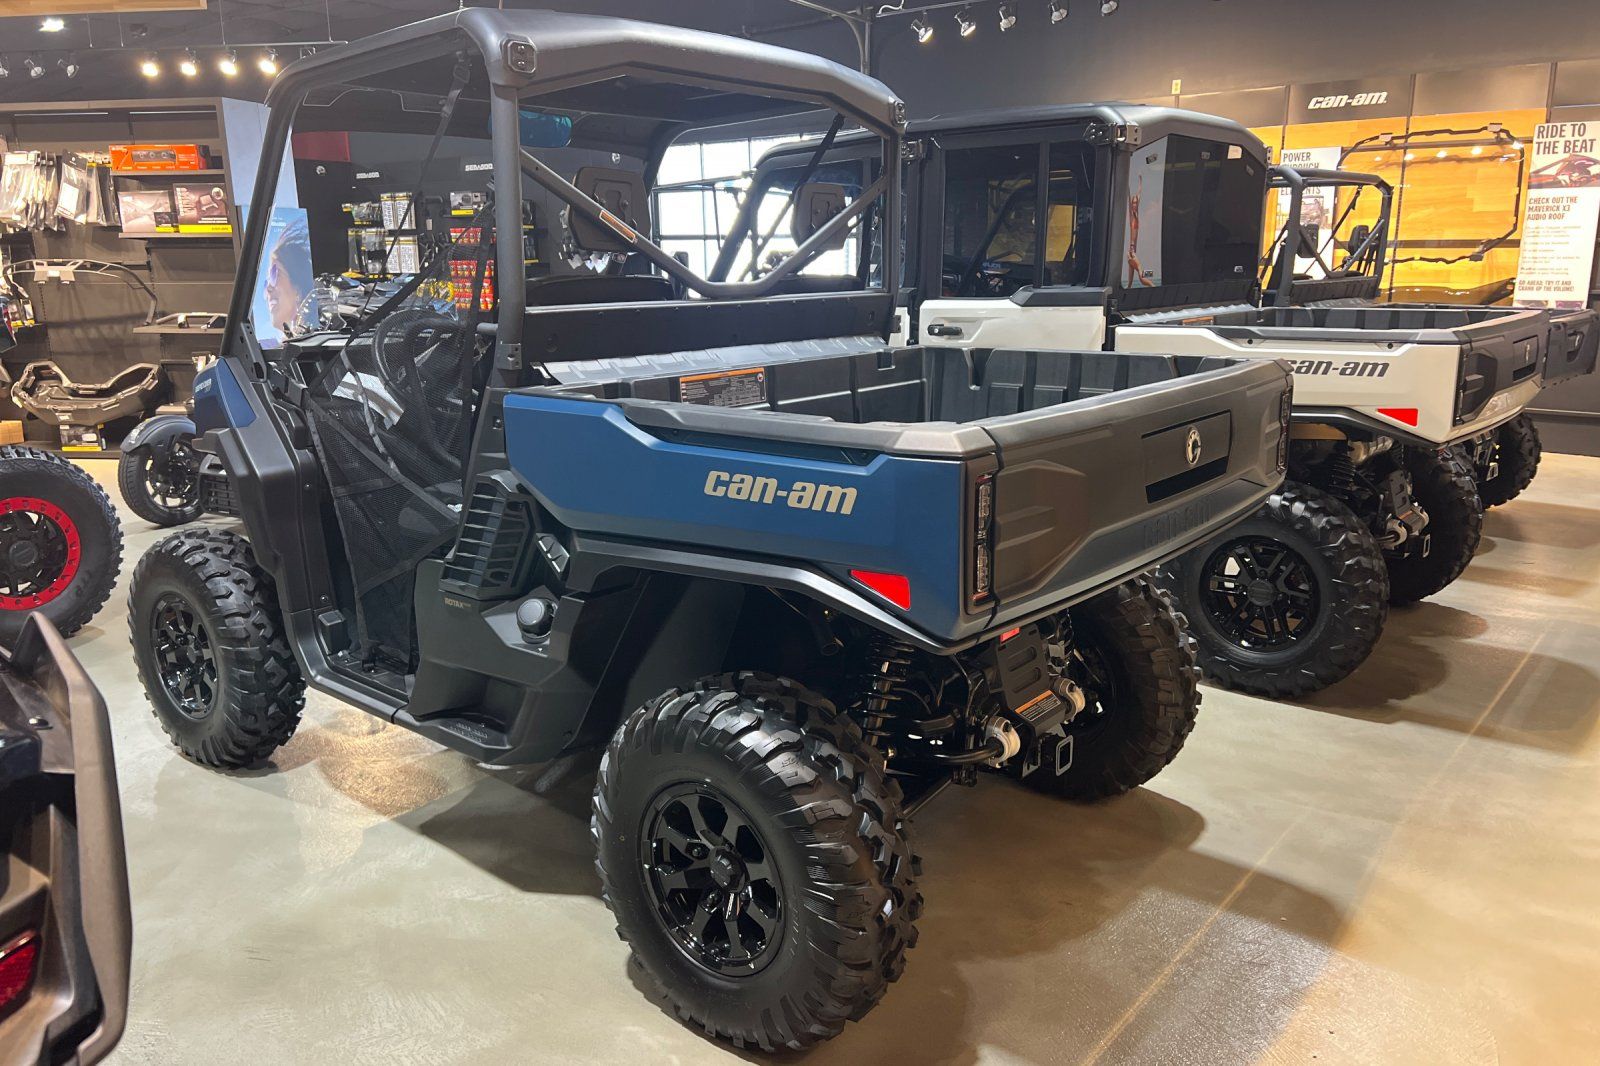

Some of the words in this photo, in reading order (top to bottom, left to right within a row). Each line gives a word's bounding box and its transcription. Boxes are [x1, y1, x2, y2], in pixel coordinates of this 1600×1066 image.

[1307, 91, 1387, 109] can-am
[1536, 124, 1567, 139] RIDE
[1570, 122, 1587, 137] TO
[1535, 140, 1560, 155] THE
[1563, 138, 1597, 154] BEAT
[1283, 152, 1312, 162] POWER
[1280, 186, 1321, 195] ELNTS
[1528, 197, 1550, 205] CHECK
[1552, 196, 1564, 204] OUT
[1527, 204, 1560, 213] MAVERICK
[1527, 213, 1547, 221] AUDIO
[1548, 212, 1565, 220] ROOF
[703, 470, 858, 515] can-am
